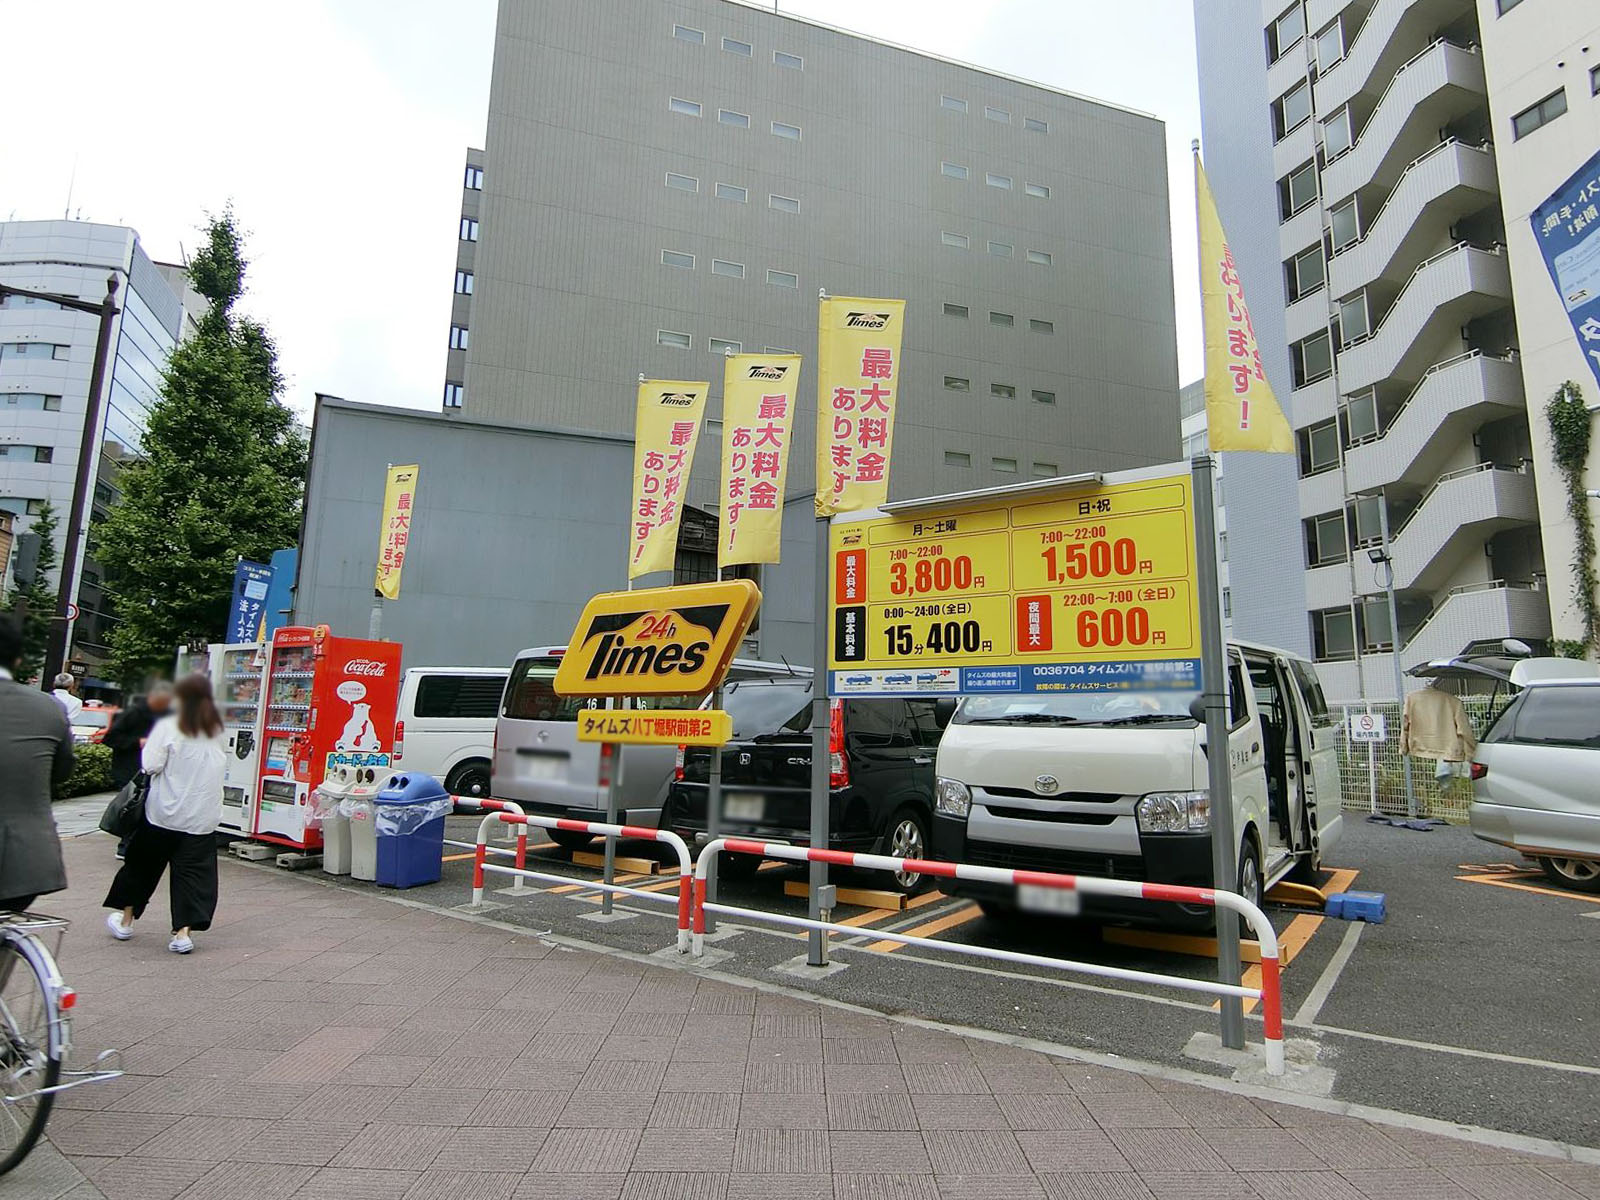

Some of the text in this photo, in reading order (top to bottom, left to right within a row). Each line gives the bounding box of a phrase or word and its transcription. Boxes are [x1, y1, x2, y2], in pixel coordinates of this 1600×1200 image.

[847, 312, 890, 328] Times
[749, 366, 788, 380] Times
[660, 392, 696, 406] Times
[856, 348, 892, 482] 最大料金
[748, 394, 787, 509] 最大料金
[831, 387, 856, 505] あります
[658, 422, 695, 528] 最大料金
[728, 427, 751, 551] あります！
[633, 451, 664, 564] あります！
[1079, 499, 1112, 515] 日・祝
[394, 493, 411, 569] 最大料金
[913, 520, 957, 536] 月～土曜
[1041, 525, 1106, 544] 7:00～22:00
[889, 545, 943, 561] 7:00～22:00
[1041, 537, 1152, 585] 1,500円
[846, 555, 856, 599] 最大料金
[890, 555, 985, 596] 3,800円
[635, 614, 676, 641] 24h
[884, 602, 972, 619] 0:00～24:00（全日）
[1028, 601, 1040, 646] 夜間最大
[1077, 606, 1166, 648] 600円
[845, 611, 856, 656] 基本料金
[884, 620, 993, 656] 15分400円
[344, 659, 387, 676] Coca-Cola
[585, 632, 710, 681] Times
[1033, 665, 1085, 675] 0036704
[586, 698, 598, 711] 16
[584, 717, 711, 737] タイムズ八丁堀駅前第2
[787, 757, 812, 765] CR-
